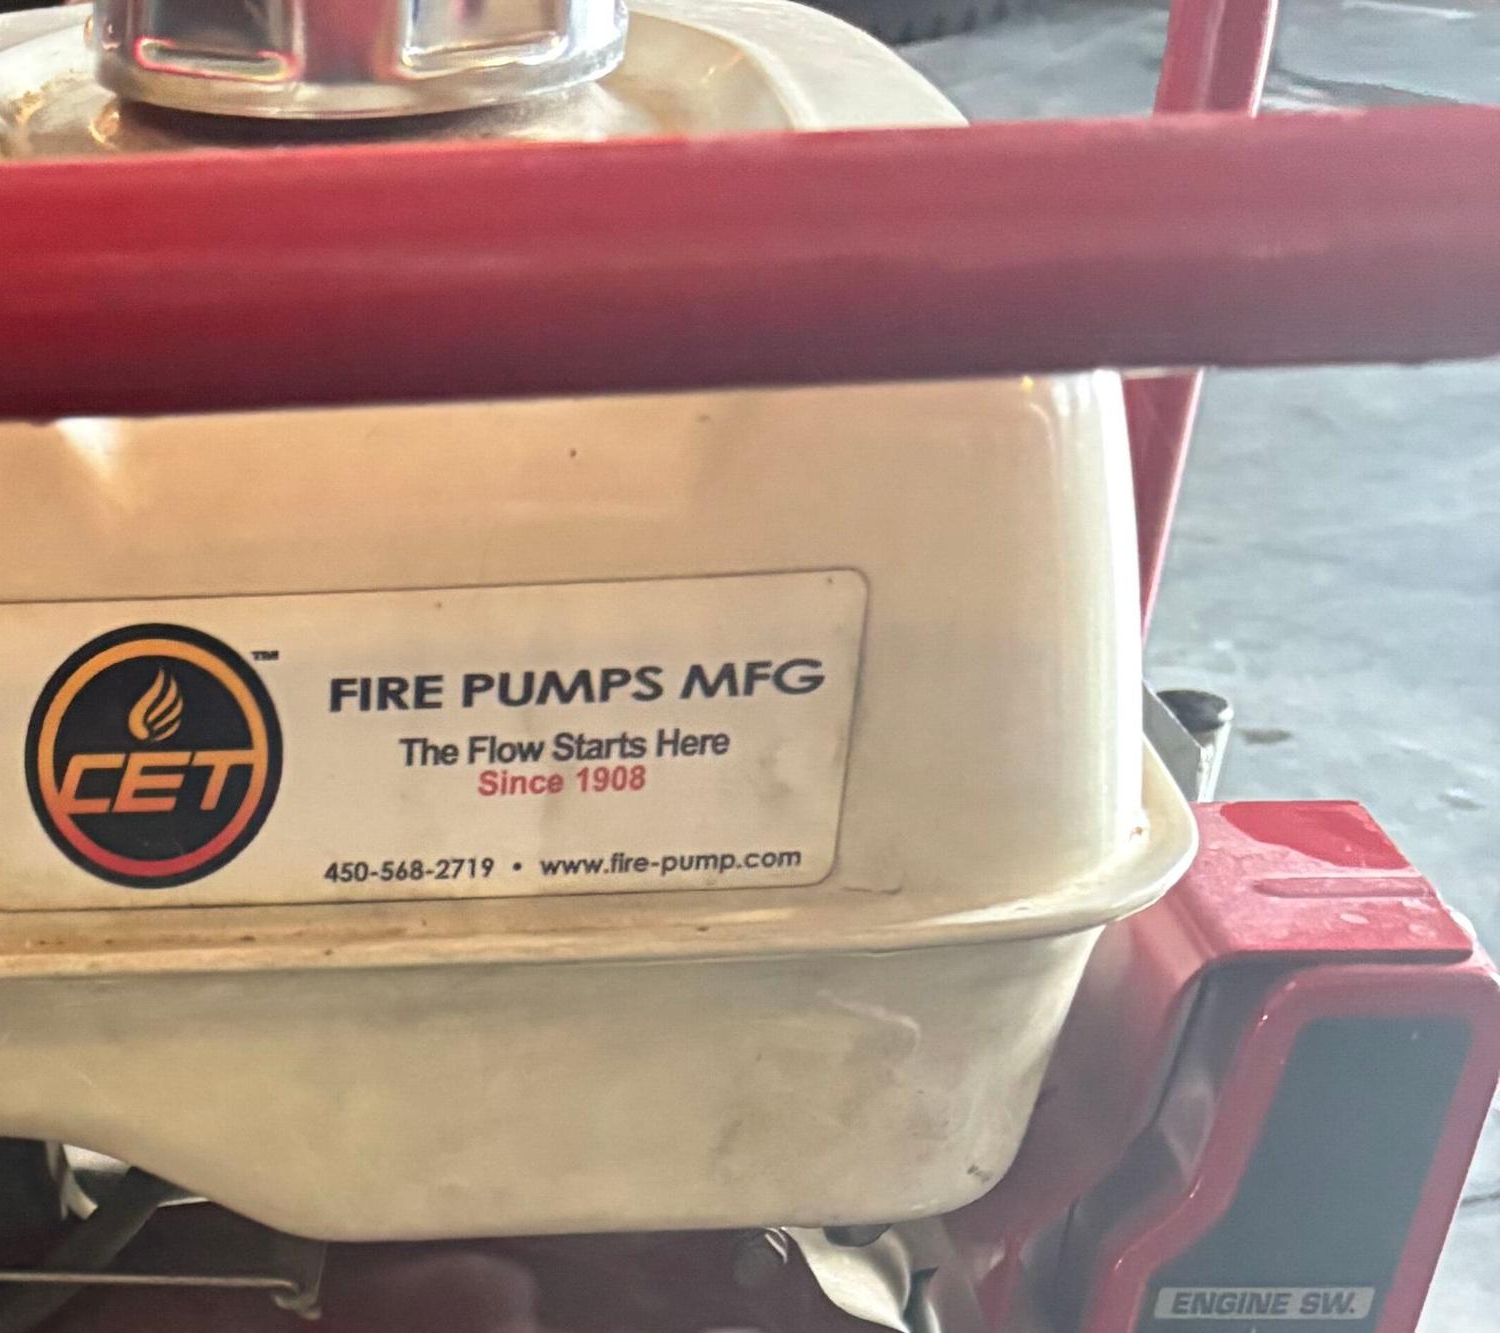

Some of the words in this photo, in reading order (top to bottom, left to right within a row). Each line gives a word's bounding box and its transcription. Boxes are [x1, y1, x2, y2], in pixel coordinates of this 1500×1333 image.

[328, 674, 445, 713] FIRE
[462, 666, 664, 709] PUMPS
[681, 658, 826, 701] MFG
[400, 736, 460, 768] The
[466, 733, 544, 766] Flow
[551, 729, 647, 761] Starts
[655, 728, 731, 759] Here
[58, 749, 262, 814] CET
[478, 769, 564, 798] Since
[576, 764, 647, 794] 1908
[323, 857, 495, 883] 450-568-2719
[540, 848, 802, 882] www.fire-pump.com
[1171, 1292, 1288, 1315] ENGINE
[1299, 1291, 1356, 1315] SW.
